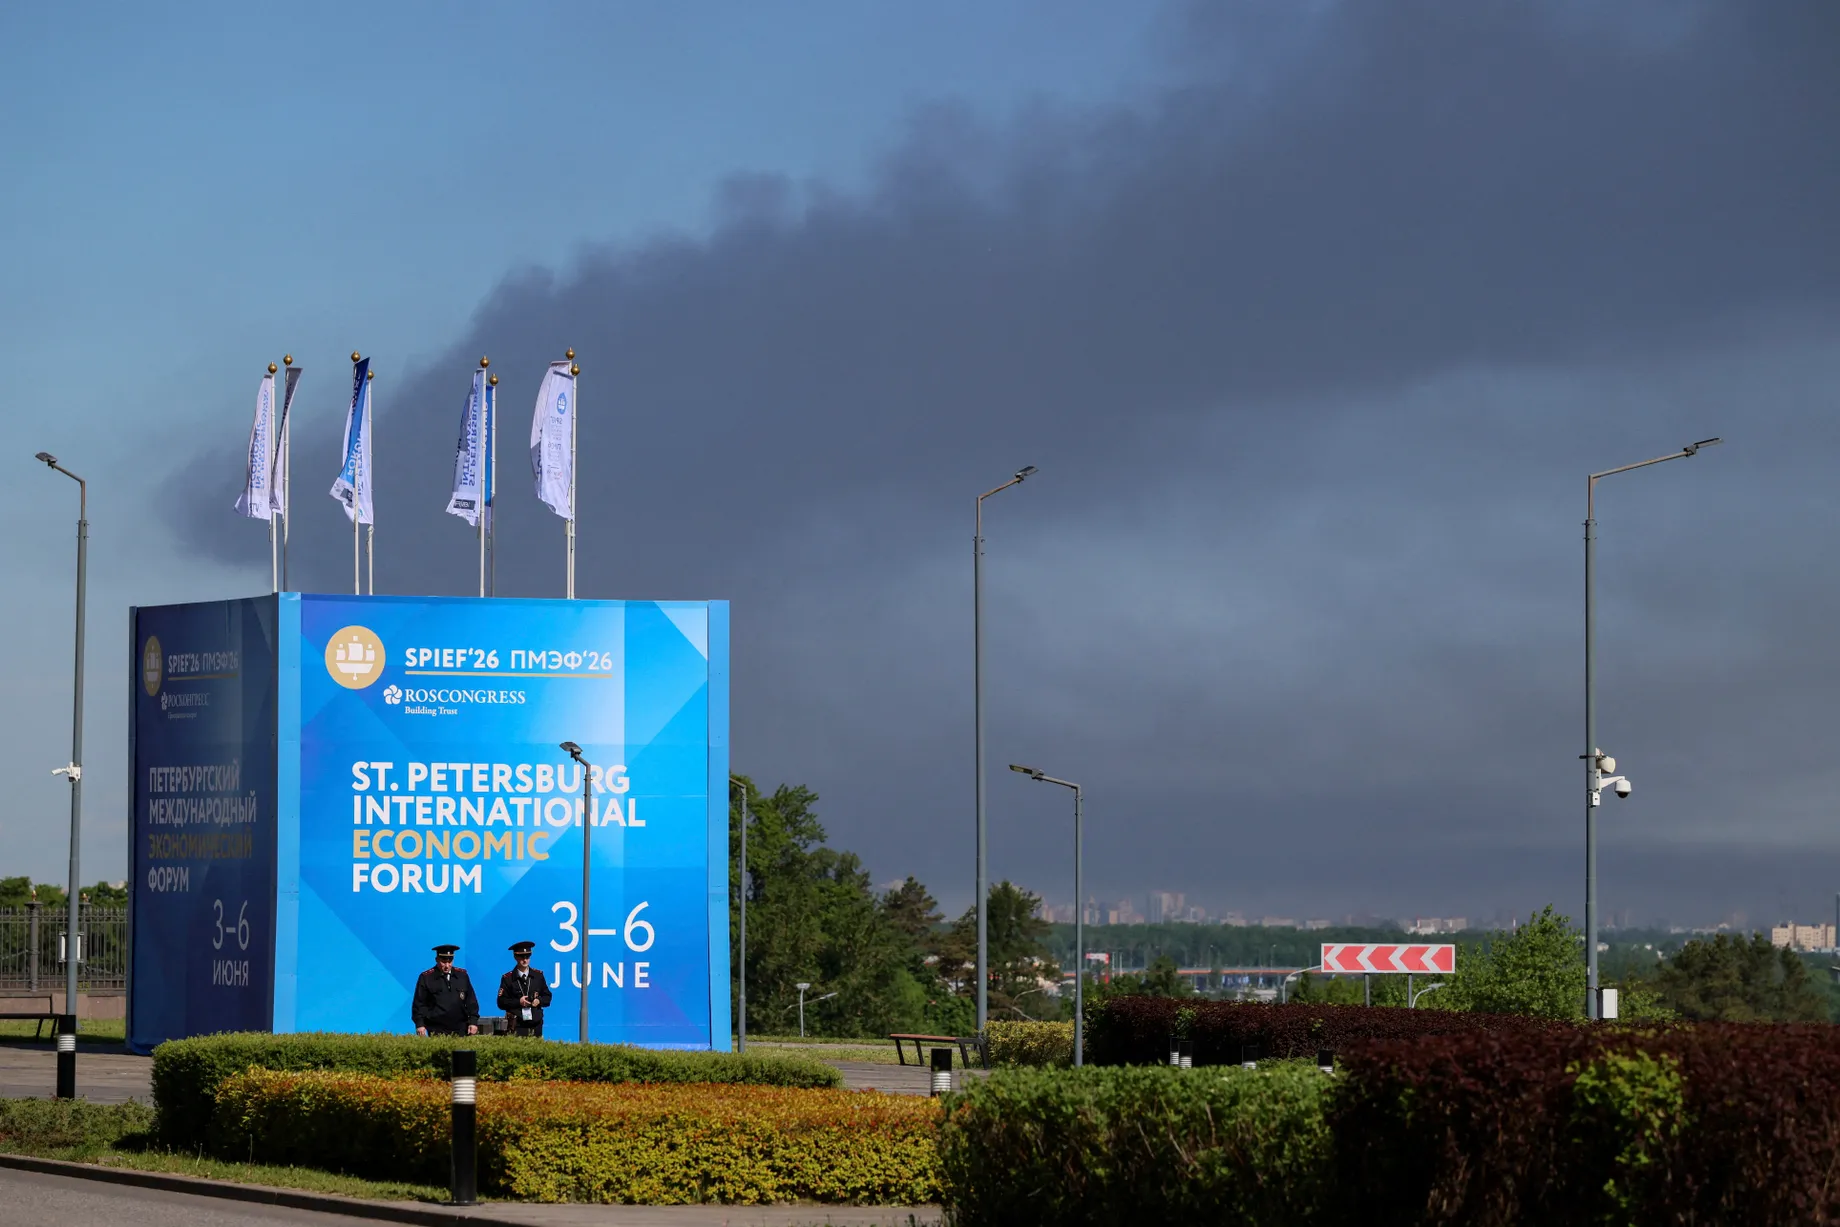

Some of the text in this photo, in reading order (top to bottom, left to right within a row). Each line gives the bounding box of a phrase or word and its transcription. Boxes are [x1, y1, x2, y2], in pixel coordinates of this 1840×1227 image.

[168, 653, 200, 673] SPIEF'26
[406, 647, 613, 671] SPIEF'26 ПМЭФ'26
[405, 688, 526, 704] ROSCONGRESS
[405, 706, 458, 717] Building Trust
[149, 758, 240, 793] ПЕТЕРБУРГСКИЙ
[352, 762, 630, 794] ST. PETERSBURG
[149, 790, 257, 828] МЕЖДУНАРОДНЫЙ
[353, 794, 646, 827] INTERNATIONAL
[353, 830, 550, 861] ECONOMIC
[148, 866, 189, 893] ФОРУМ
[353, 863, 482, 894] FORUM
[213, 959, 249, 986] ИЮНЯ
[550, 962, 650, 989] JUNE
